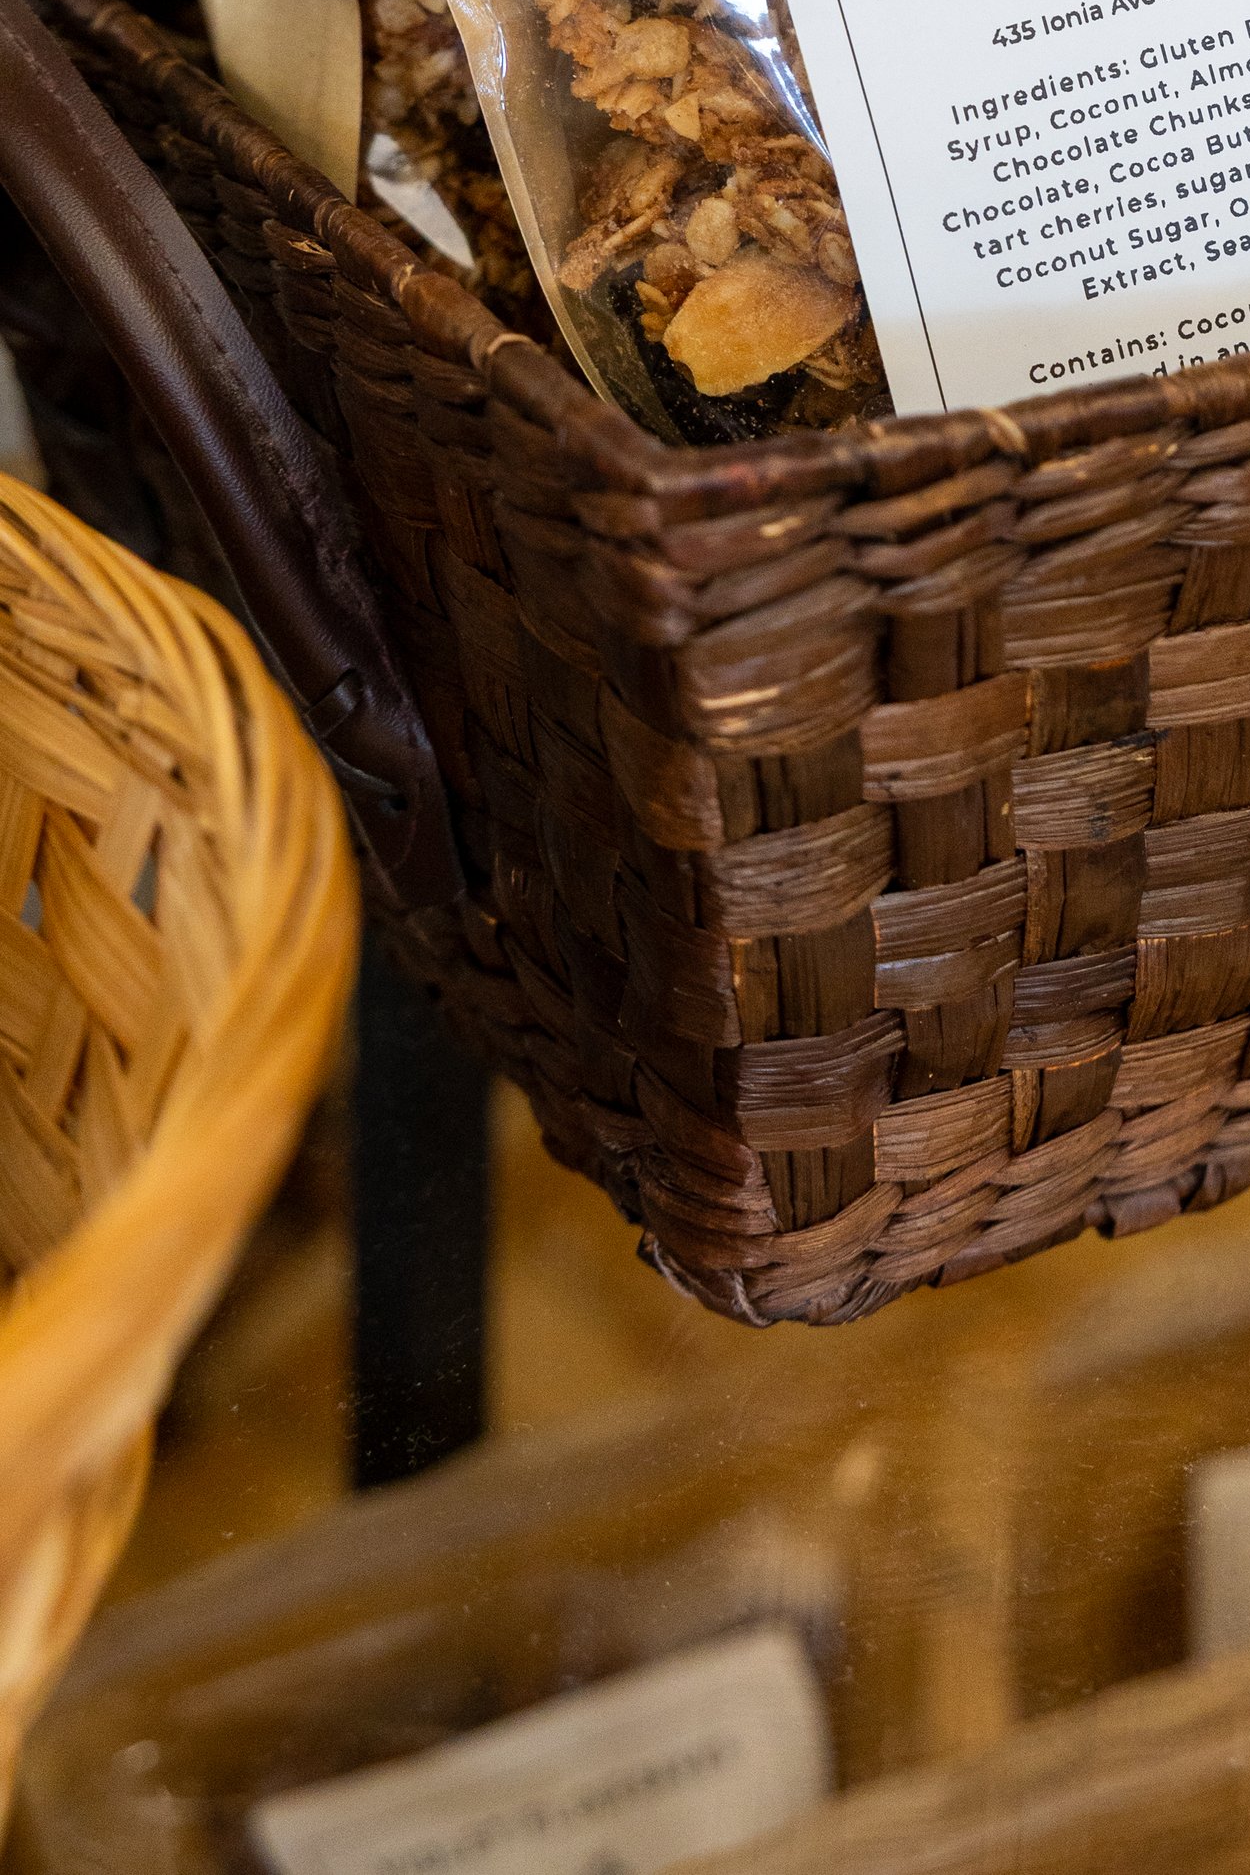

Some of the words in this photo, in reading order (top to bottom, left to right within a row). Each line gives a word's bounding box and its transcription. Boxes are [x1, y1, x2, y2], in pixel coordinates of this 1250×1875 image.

[991, 19, 1037, 48] 435
[1041, 1, 1105, 36] Ionia
[950, 58, 1131, 126] Ingredients:
[1139, 29, 1235, 70] Gluten
[946, 124, 1041, 163] Syrup,
[1049, 80, 1180, 131] Coconut,
[992, 127, 1139, 183] Chocolate
[941, 177, 1100, 233] Chocolate,
[1108, 146, 1196, 184] Cocoa
[972, 227, 1030, 260] tart
[1039, 191, 1167, 240] cherries,
[995, 237, 1119, 289] Coconut
[1127, 211, 1221, 250] Sugar,
[1081, 252, 1196, 301] Extract,
[1028, 330, 1168, 384] Contains:
